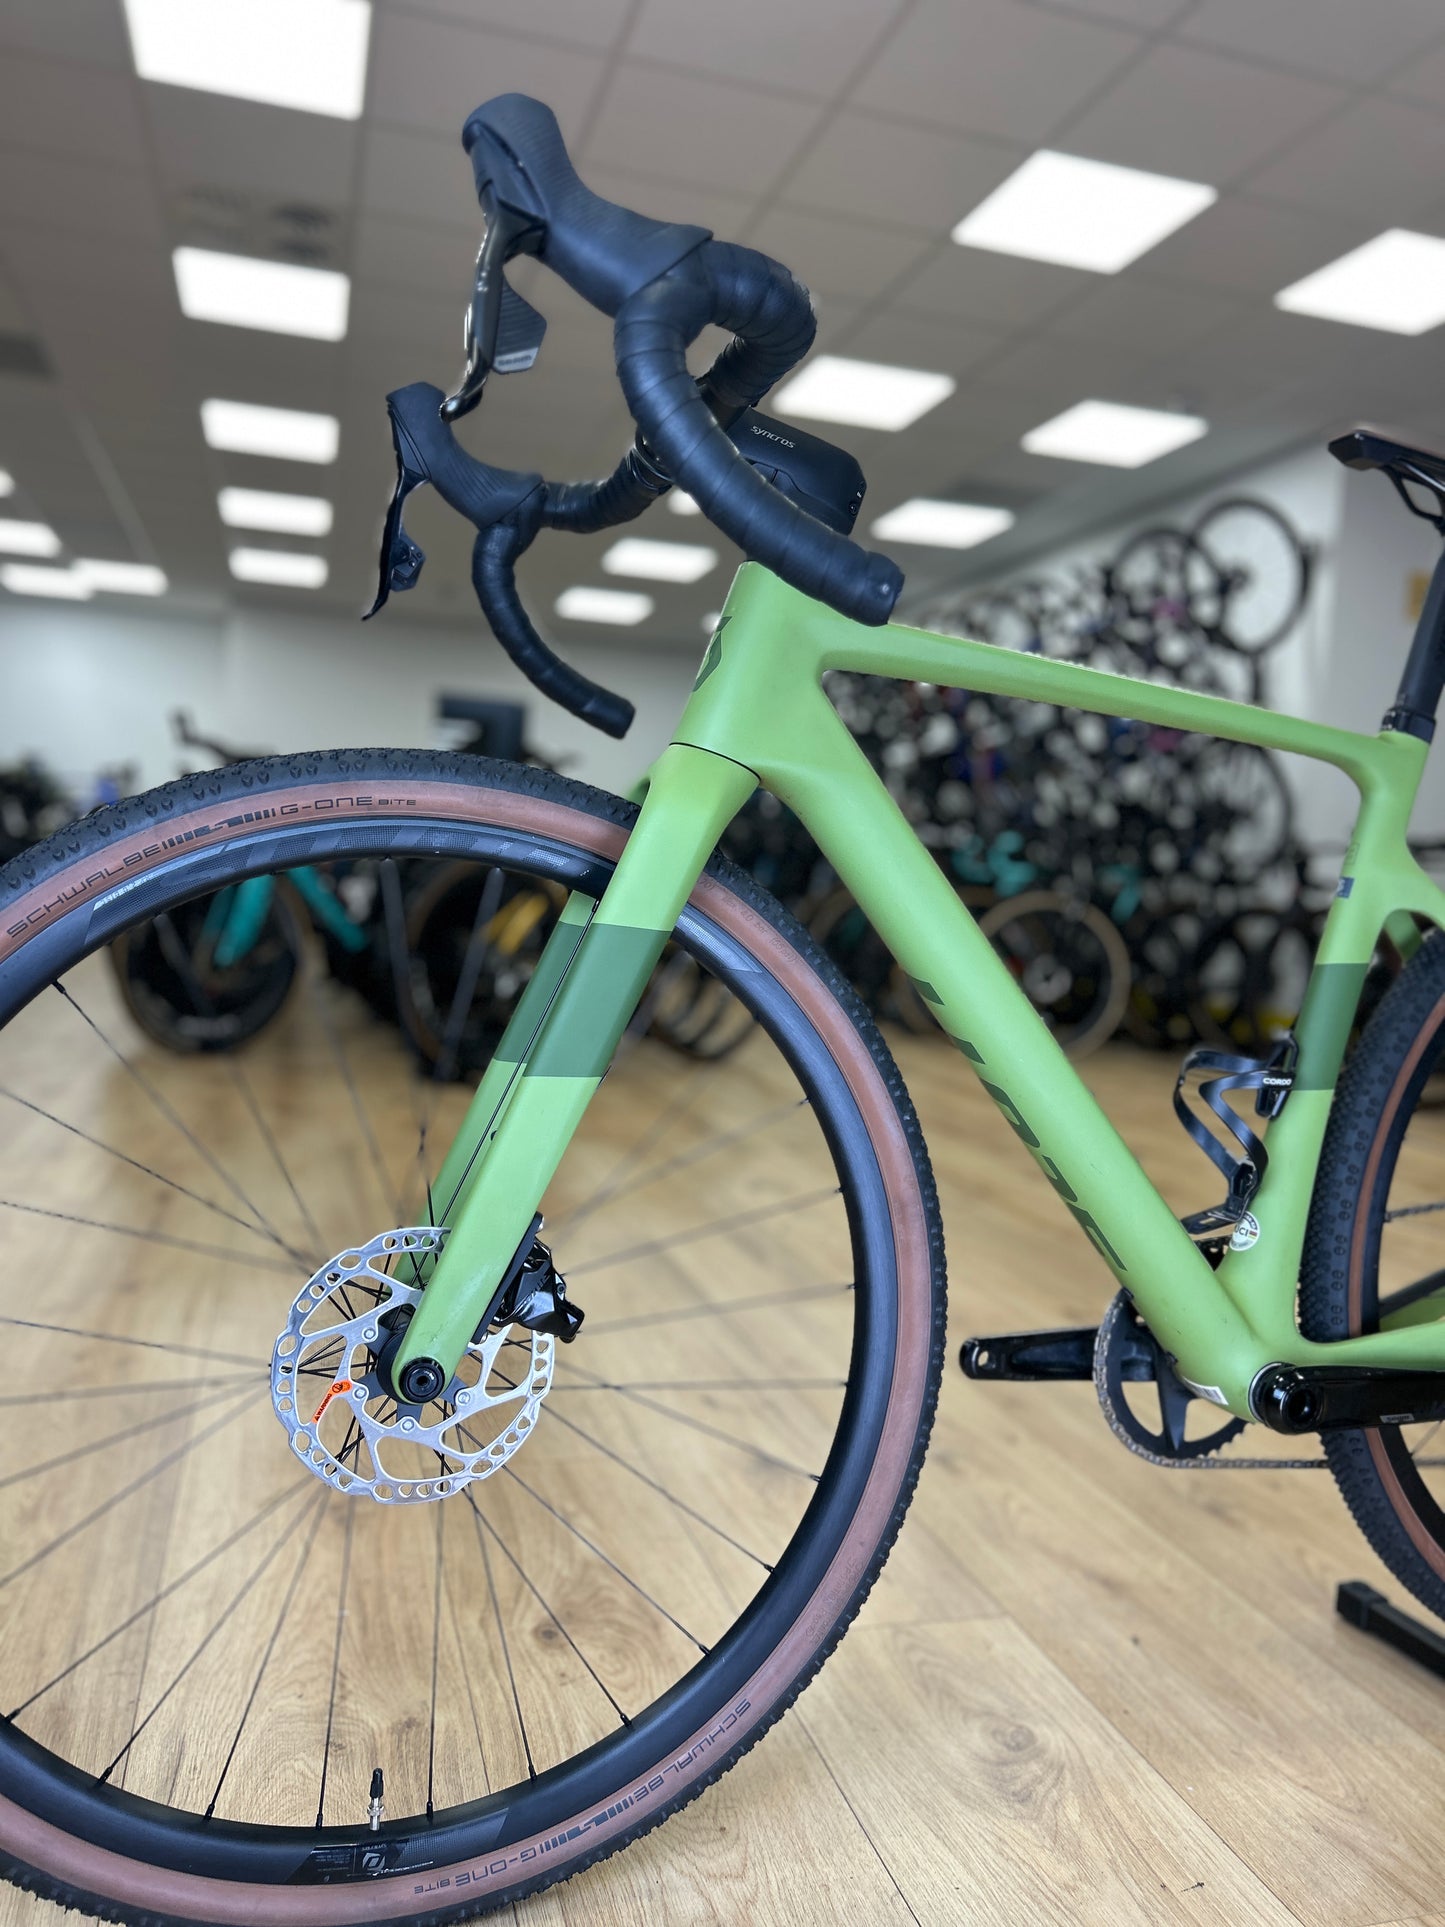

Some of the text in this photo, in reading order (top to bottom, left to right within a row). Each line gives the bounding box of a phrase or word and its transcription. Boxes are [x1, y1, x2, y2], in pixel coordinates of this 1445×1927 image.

[751, 425, 796, 449] syncros
[6, 843, 162, 938] SCHWALBE
[280, 796, 373, 816] G-ONE
[378, 798, 417, 806] BITE
[413, 1698, 752, 1895] SCHWALBE G-ONE BITE
